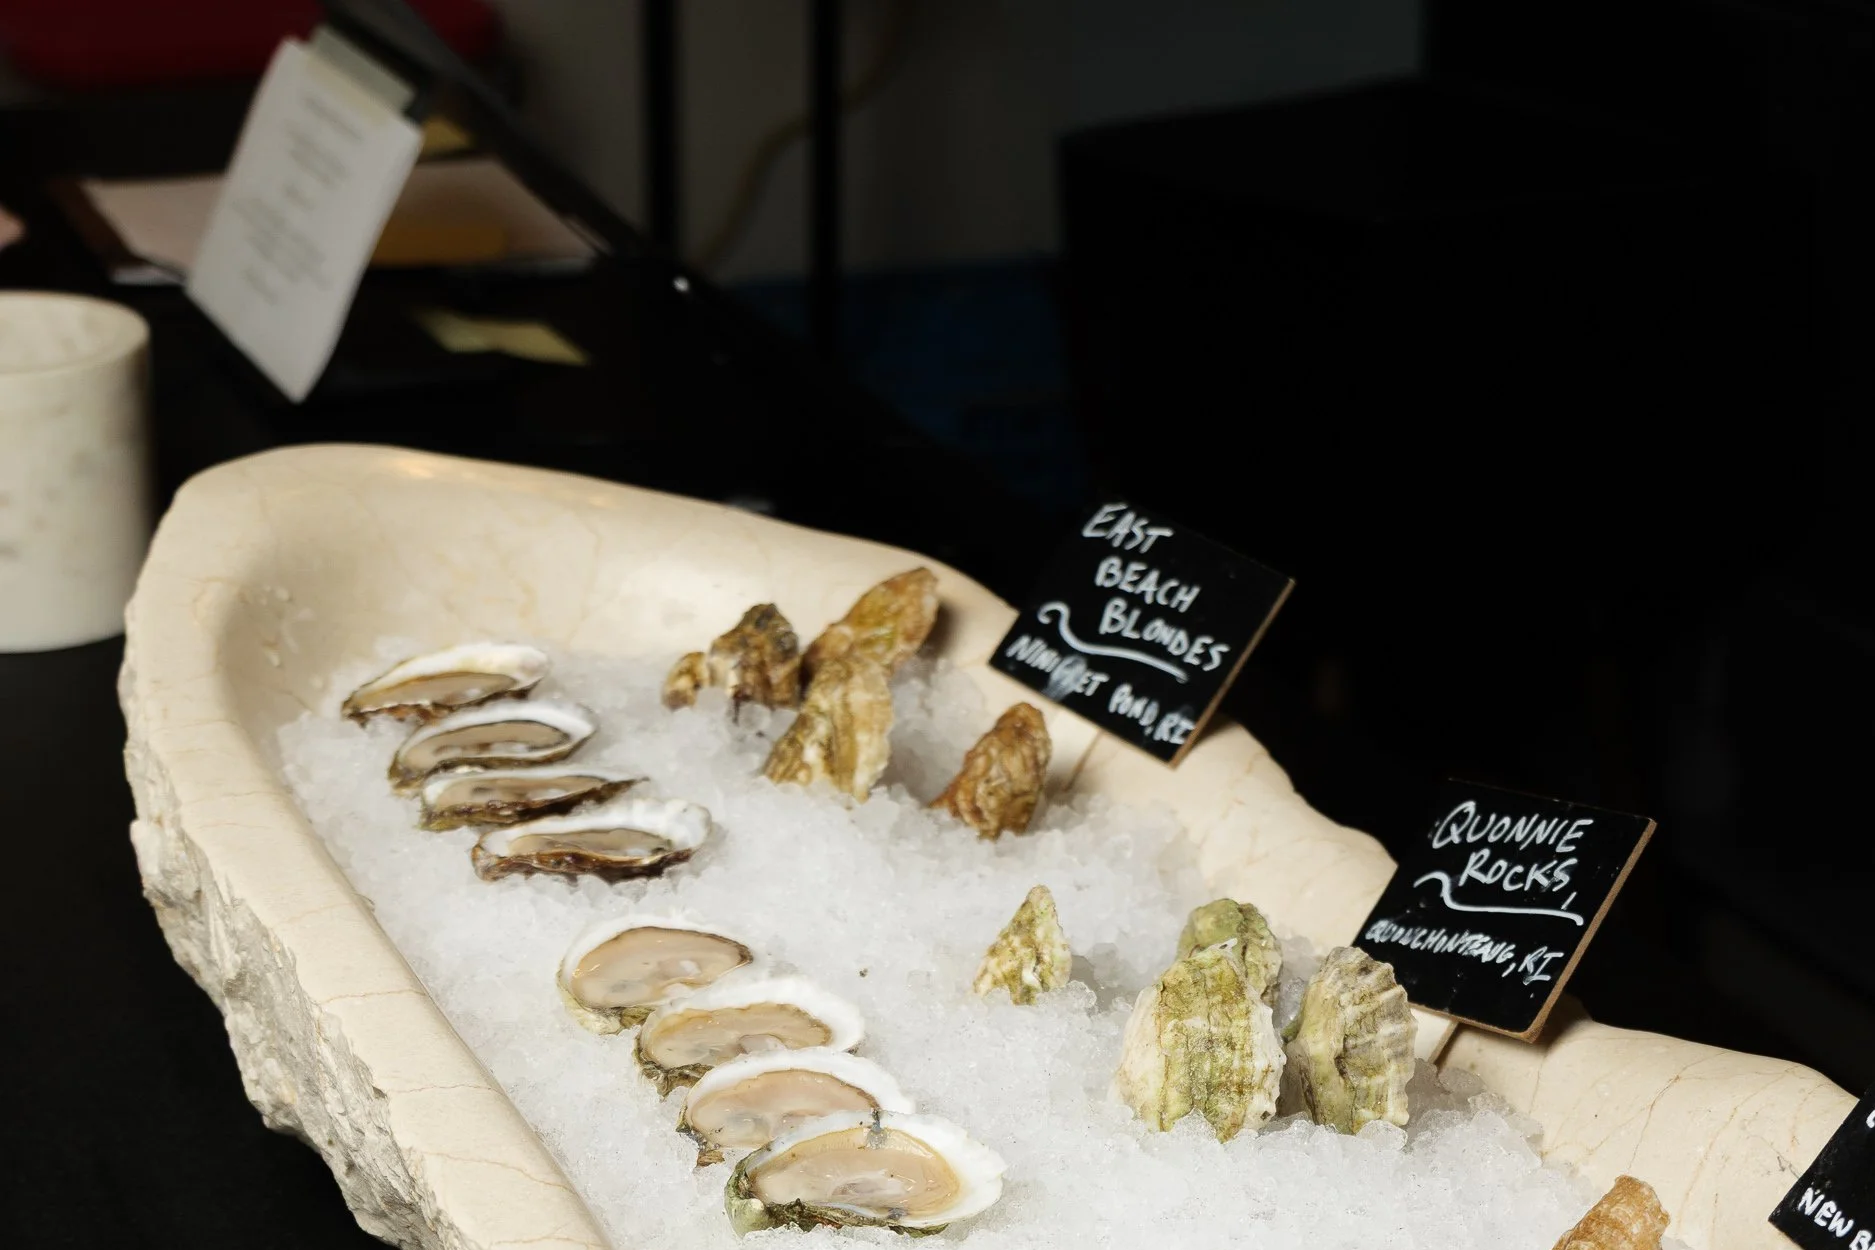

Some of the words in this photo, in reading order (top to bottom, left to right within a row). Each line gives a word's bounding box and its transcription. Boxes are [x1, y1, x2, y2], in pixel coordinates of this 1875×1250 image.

[1082, 503, 1174, 553] EAST
[1095, 556, 1201, 613] BEACH
[1099, 598, 1230, 671] BLONDES
[1432, 801, 1594, 853] QUONNIE
[1518, 946, 1564, 985] RI
[1798, 1187, 1854, 1238] NEW
